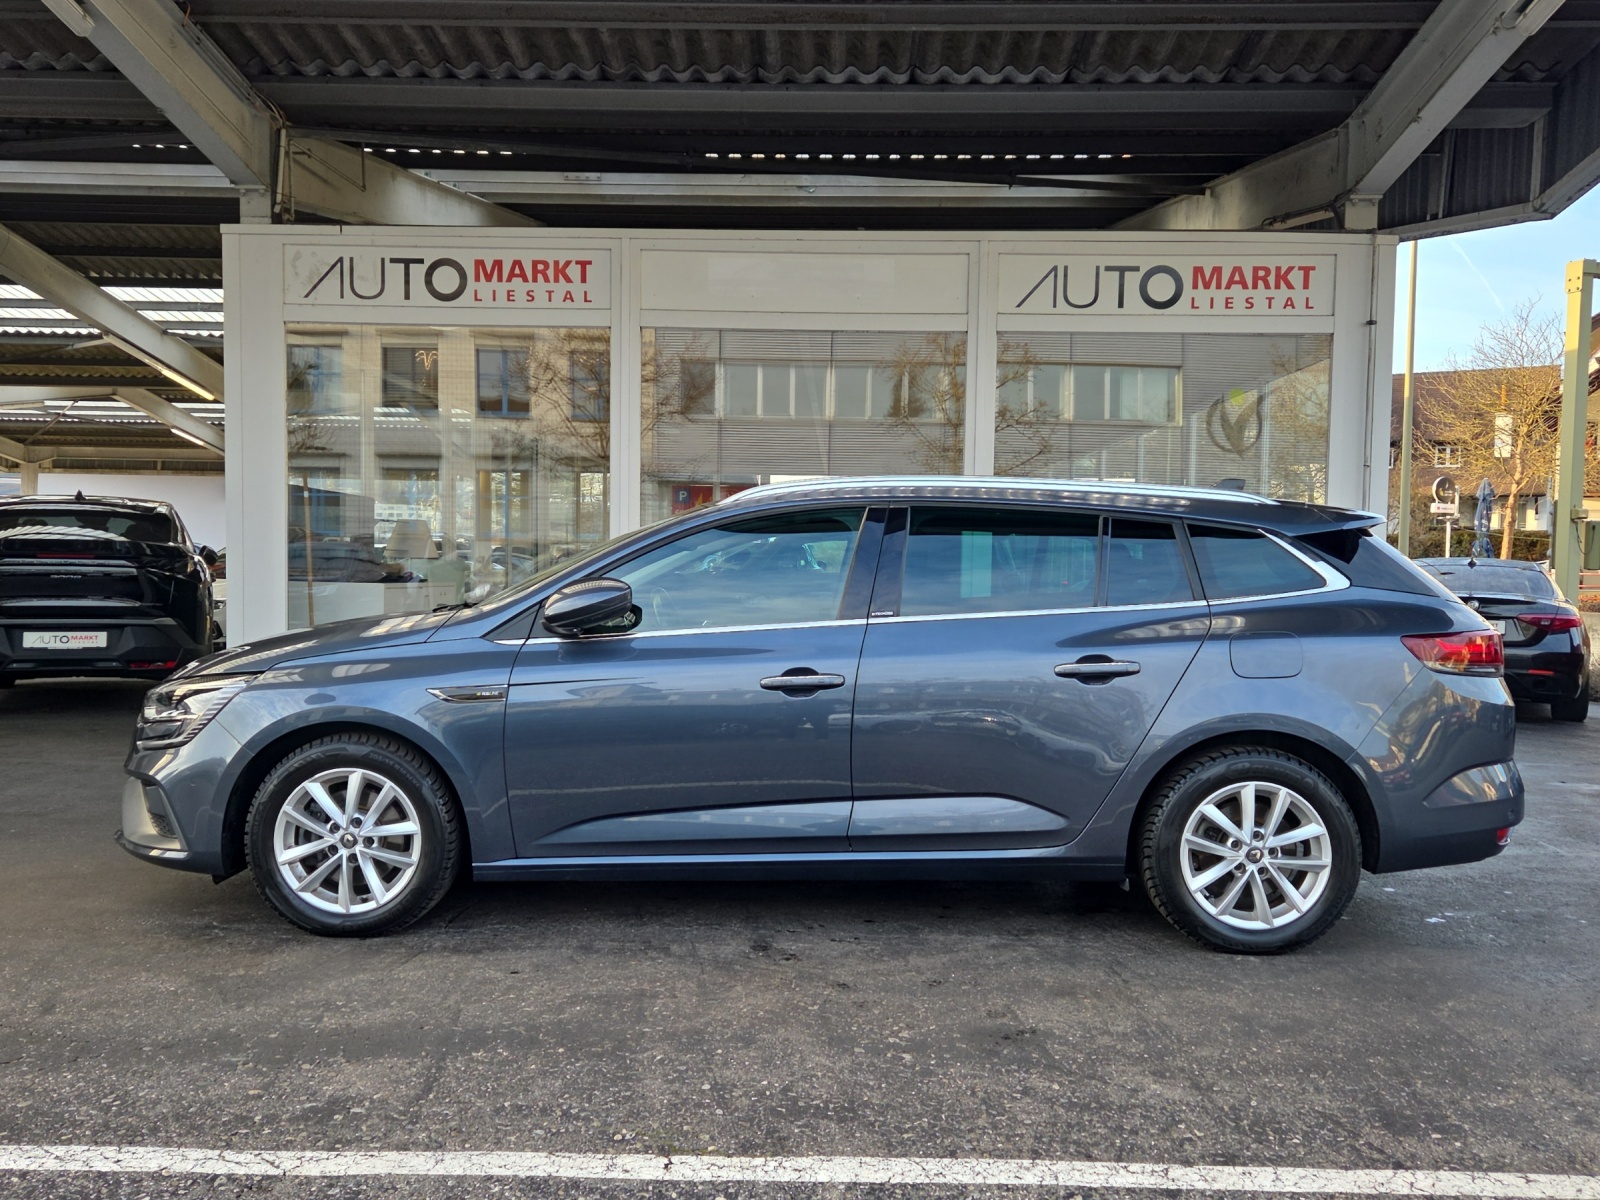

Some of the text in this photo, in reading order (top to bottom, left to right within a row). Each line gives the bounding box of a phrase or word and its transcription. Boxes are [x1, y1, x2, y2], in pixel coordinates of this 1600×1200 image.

[303, 256, 593, 302] AUTO MARKT
[1015, 264, 1317, 310] AUTO MARKT
[473, 289, 593, 303] LIESTAL
[1190, 296, 1315, 310] LIESTAL
[32, 635, 70, 645] AUTO
